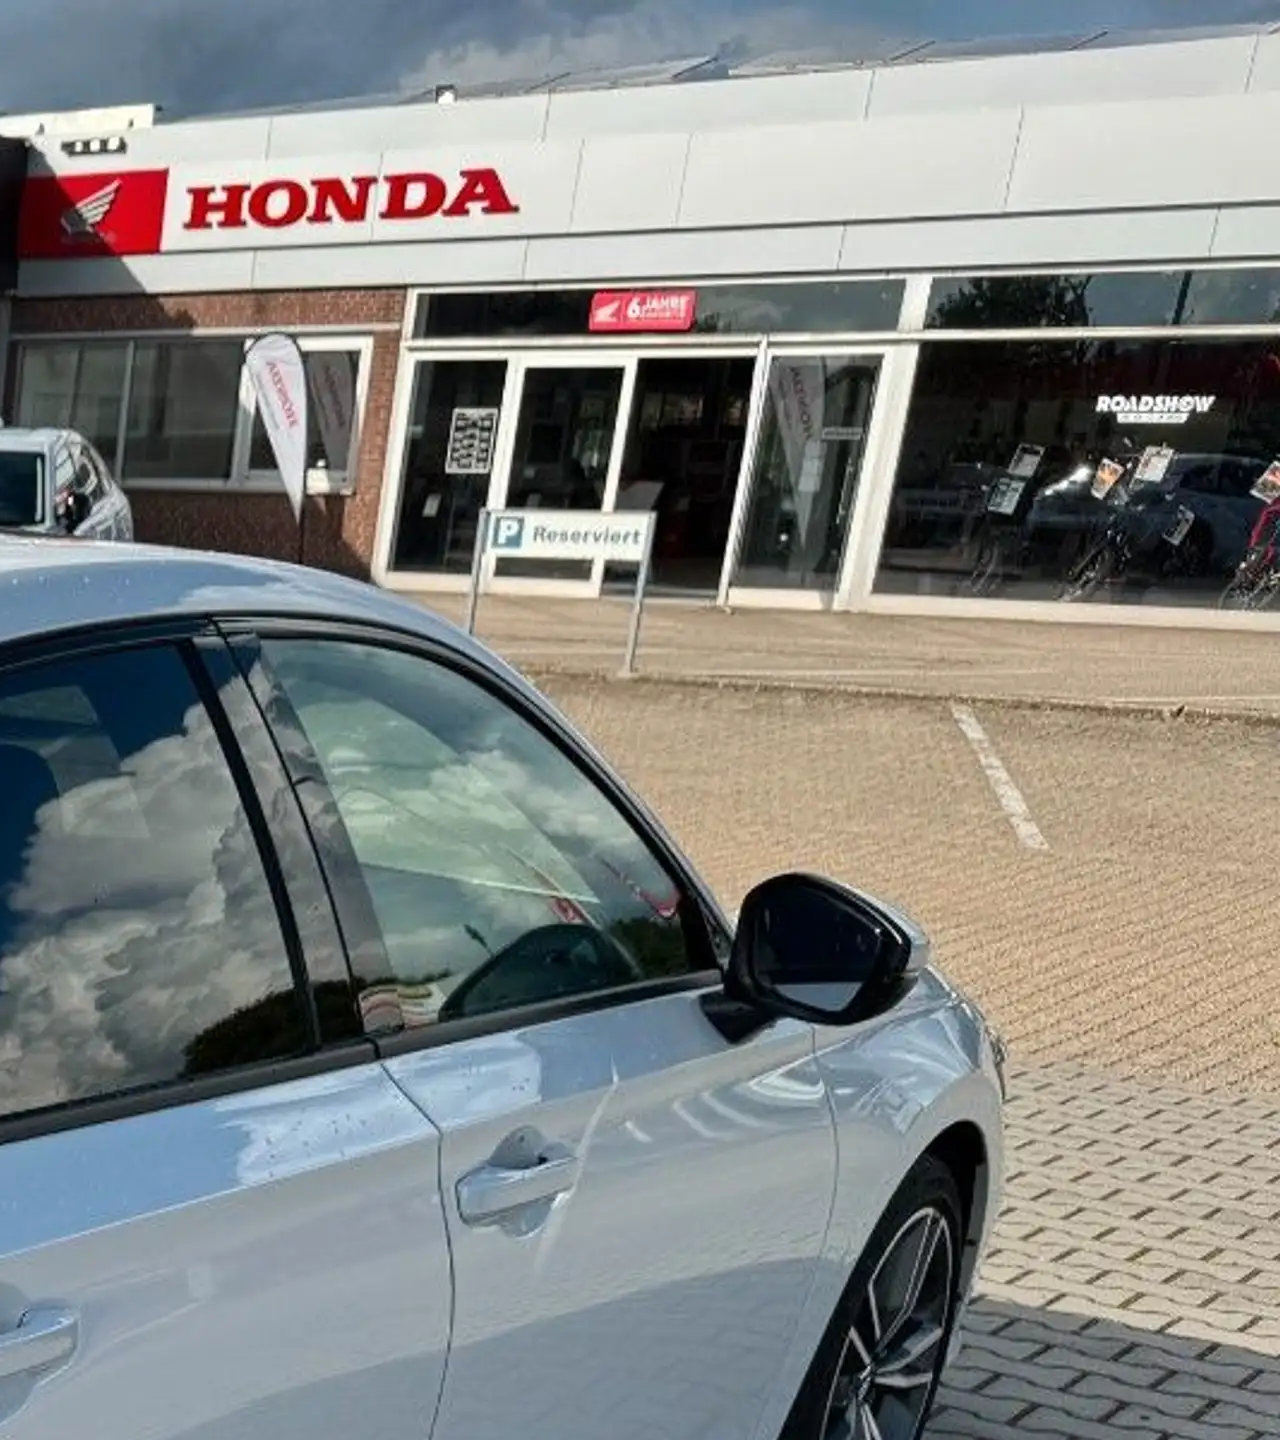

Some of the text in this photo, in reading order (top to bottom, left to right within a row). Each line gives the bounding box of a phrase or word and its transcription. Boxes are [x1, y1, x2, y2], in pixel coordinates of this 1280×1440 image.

[182, 168, 520, 231] HONDA
[1095, 395, 1217, 413] ROADSHOW
[533, 525, 642, 545] Reserviert
